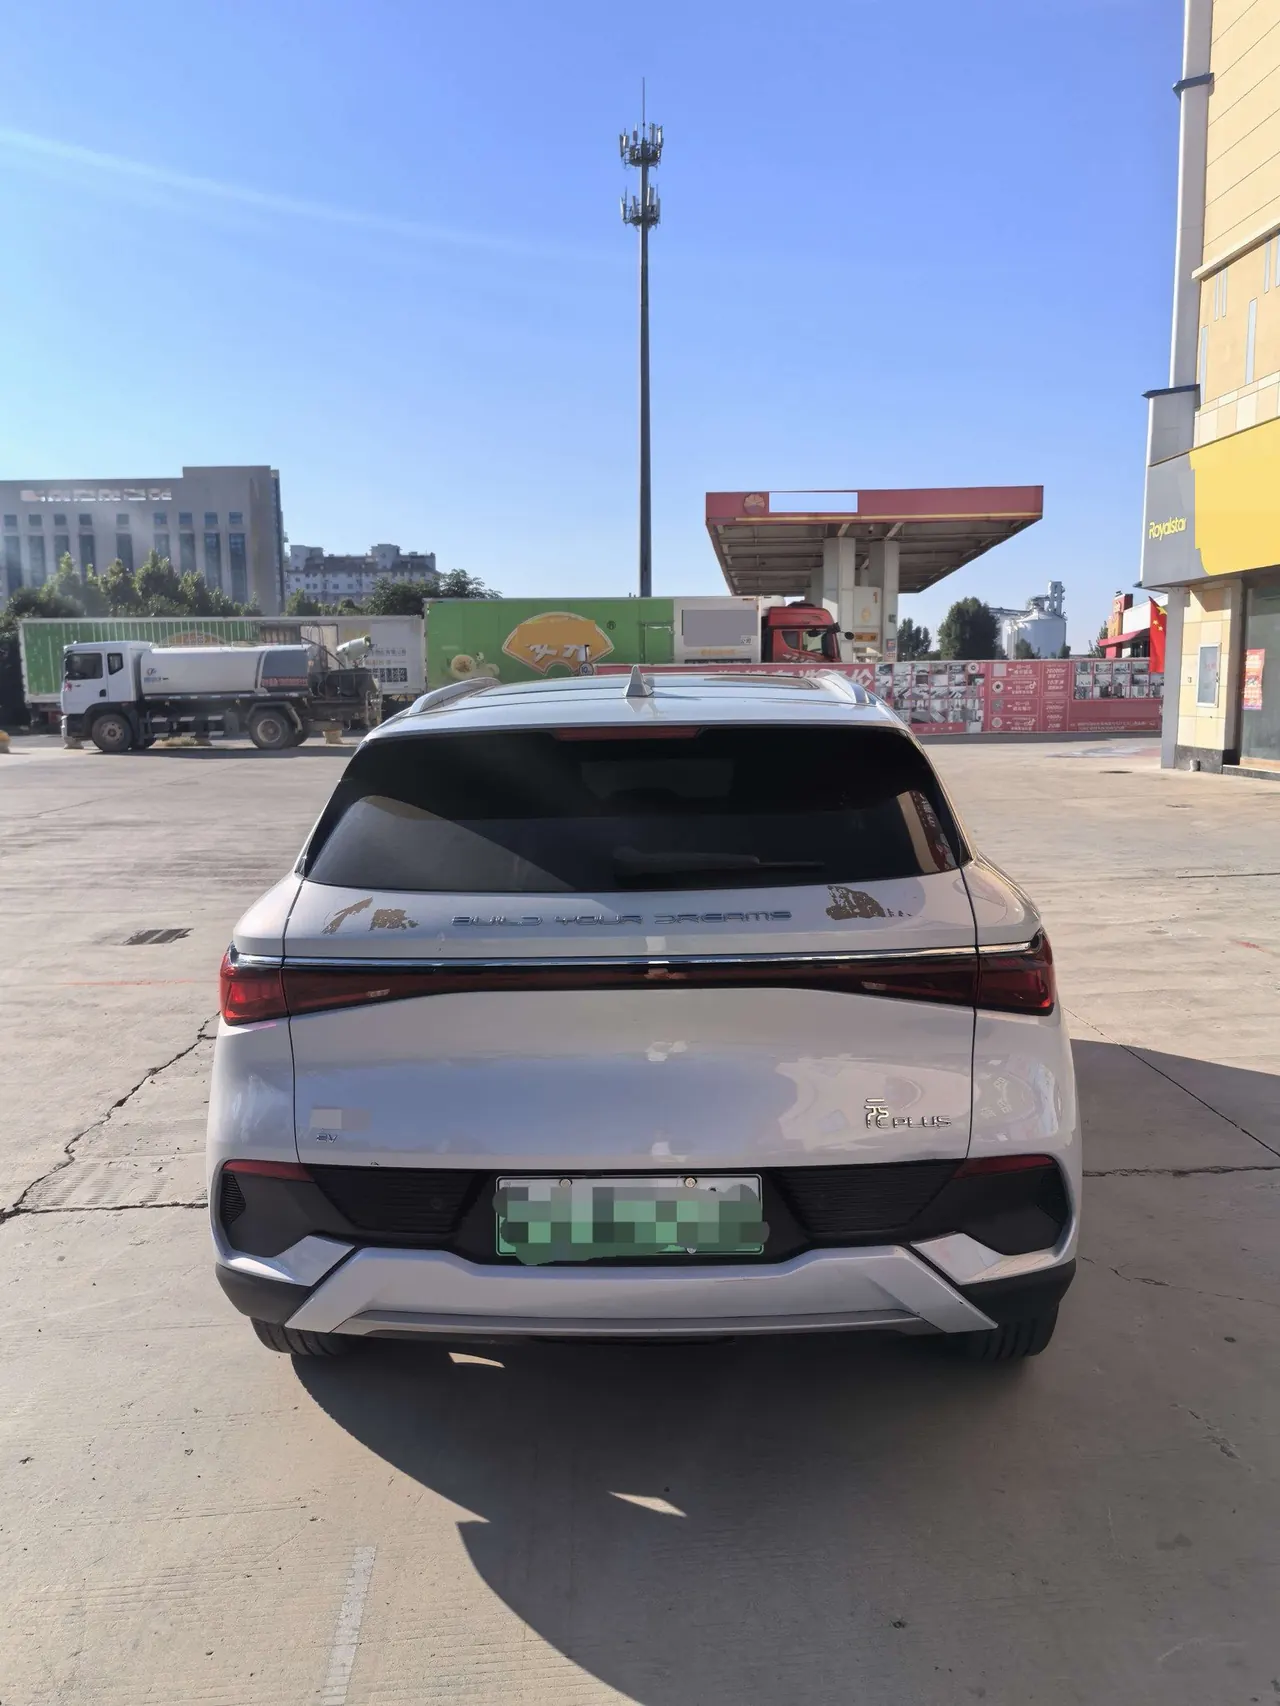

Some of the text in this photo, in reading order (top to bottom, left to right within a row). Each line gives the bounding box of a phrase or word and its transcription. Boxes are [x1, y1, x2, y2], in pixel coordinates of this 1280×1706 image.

[1149, 516, 1187, 541] Royalstar
[451, 910, 792, 928] BUILD YOUR DREAMS
[864, 1097, 952, 1129] 元 PLUS
[316, 1132, 338, 1144] EV
